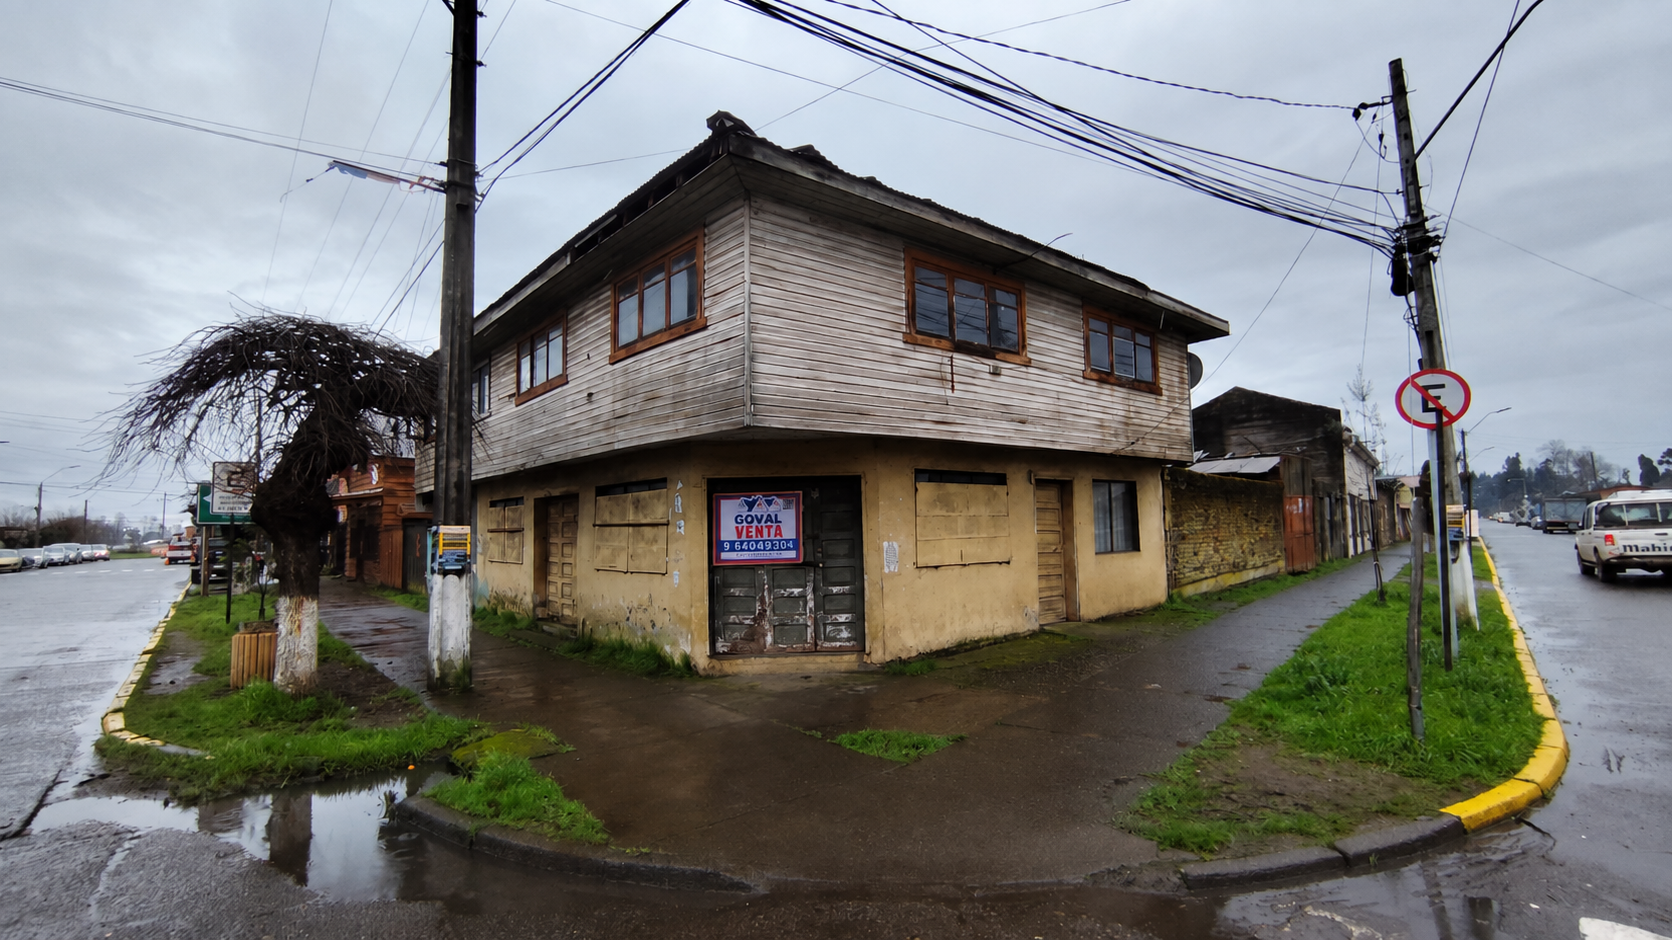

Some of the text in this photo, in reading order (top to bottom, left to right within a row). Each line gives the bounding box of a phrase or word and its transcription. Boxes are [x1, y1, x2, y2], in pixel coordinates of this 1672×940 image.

[1421, 384, 1447, 413] E
[734, 514, 782, 524] GOVAL
[735, 525, 783, 539] VENTA
[723, 541, 730, 551] 9
